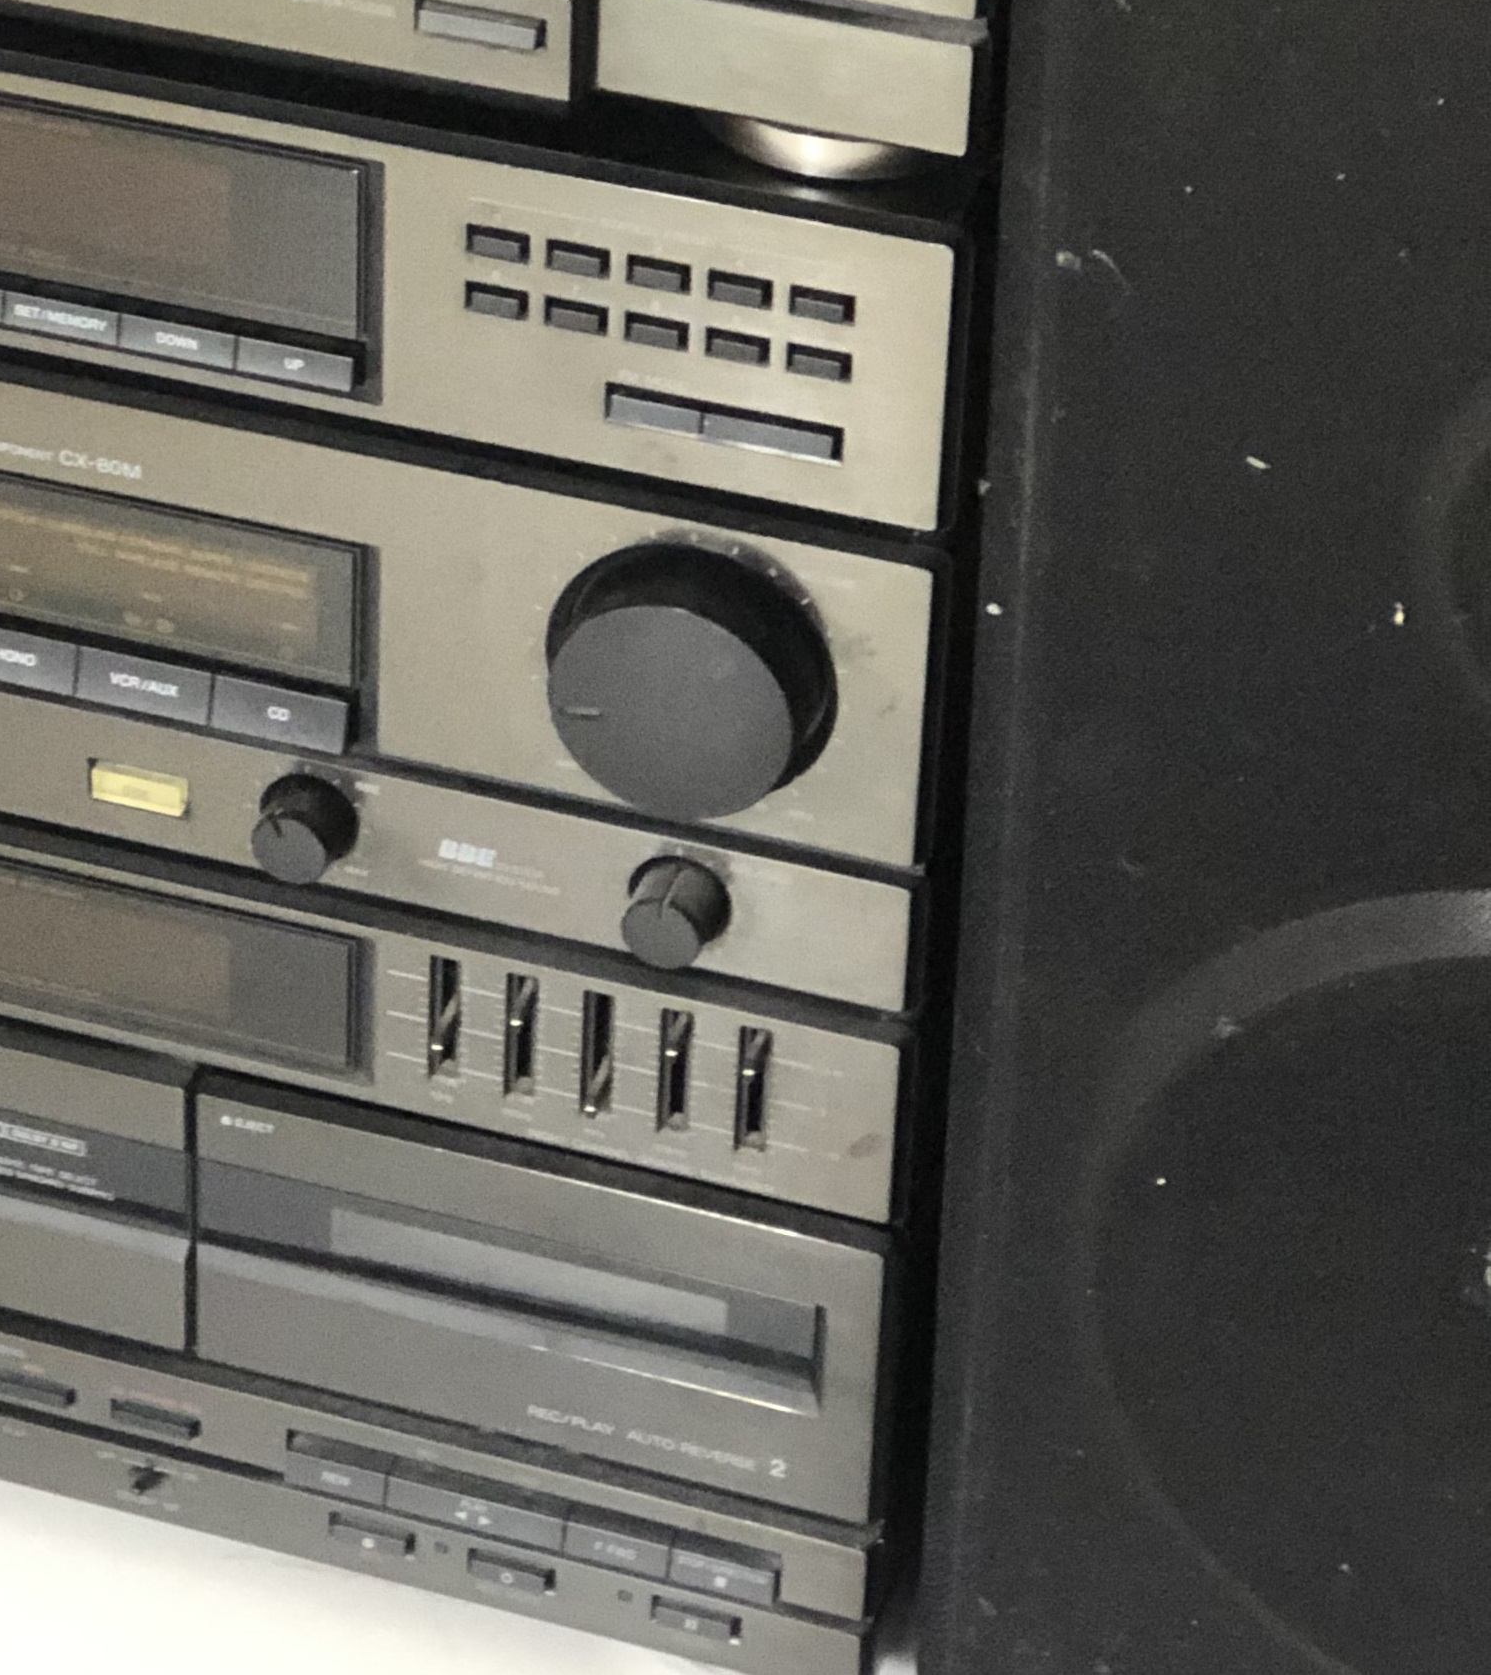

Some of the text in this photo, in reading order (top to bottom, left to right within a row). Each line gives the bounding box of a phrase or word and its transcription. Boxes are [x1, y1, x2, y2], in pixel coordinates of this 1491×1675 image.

[156, 331, 199, 351] DOWN
[284, 357, 306, 372] UP
[109, 671, 180, 698] VCR/AUX
[267, 704, 292, 722] CD
[527, 1404, 615, 1436] REC/PLAY
[769, 1457, 788, 1479] 2
